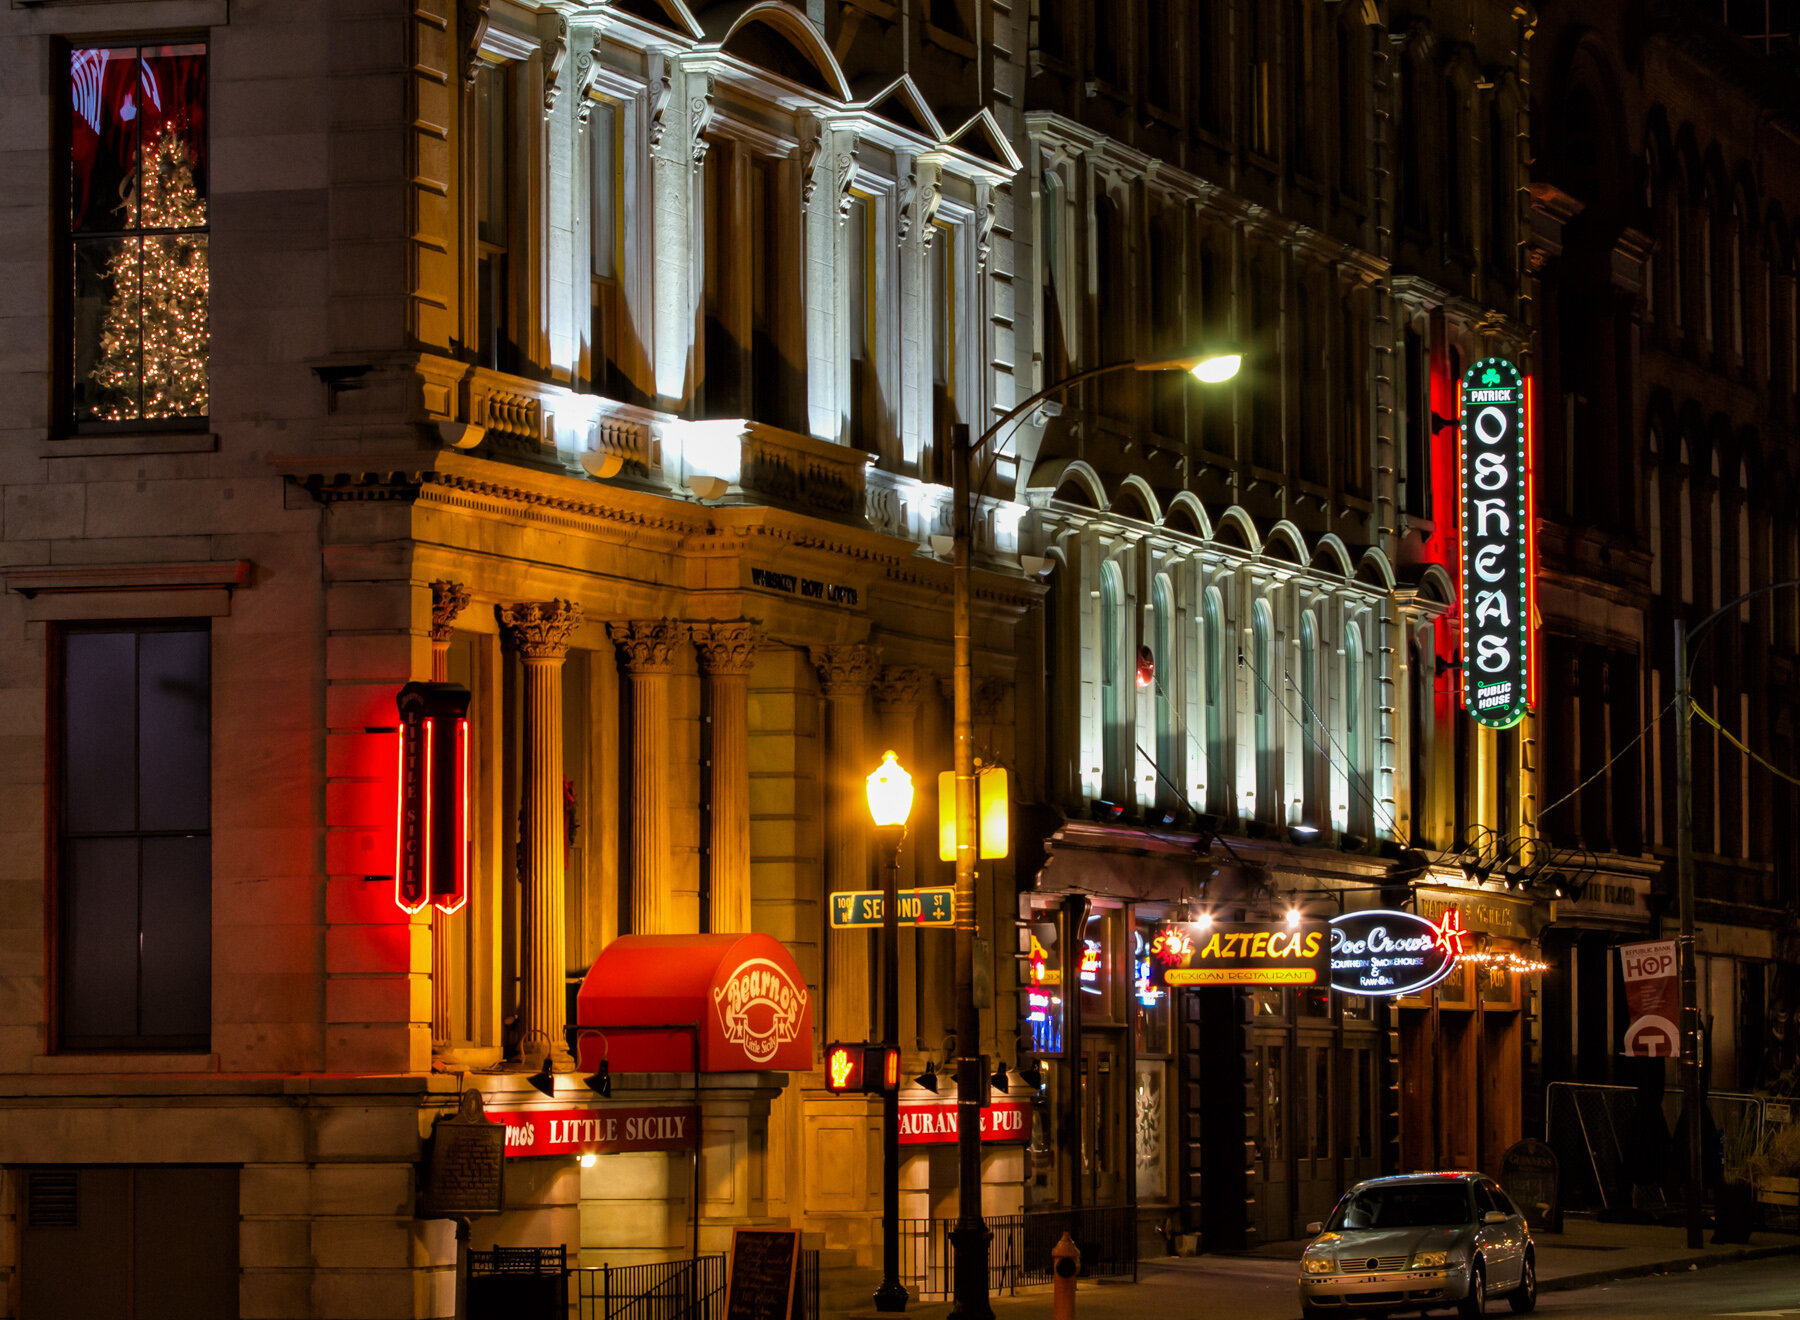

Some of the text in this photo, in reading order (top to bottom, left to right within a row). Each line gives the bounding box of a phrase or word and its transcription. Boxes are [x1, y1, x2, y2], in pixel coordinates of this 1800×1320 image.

[1471, 389, 1511, 402] PATRICK
[751, 567, 858, 605] WHISKEY ROW LOFTS
[1477, 682, 1512, 699] PUBLIC
[1478, 693, 1511, 710] HOUSE
[862, 898, 922, 920] SEND
[933, 894, 943, 906] ST
[1201, 931, 1323, 959] AZTECAS
[1367, 926, 1435, 953] Crow's
[1170, 971, 1309, 980] MEXICAN RESTAURANT
[1371, 967, 1381, 977] &
[1627, 955, 1672, 977] HOP
[725, 970, 798, 1027] Bearno's
[746, 1035, 760, 1053] Little
[549, 1118, 618, 1144] LITTLE
[625, 1116, 686, 1141] SICILY
[992, 1110, 1023, 1131] PUB
